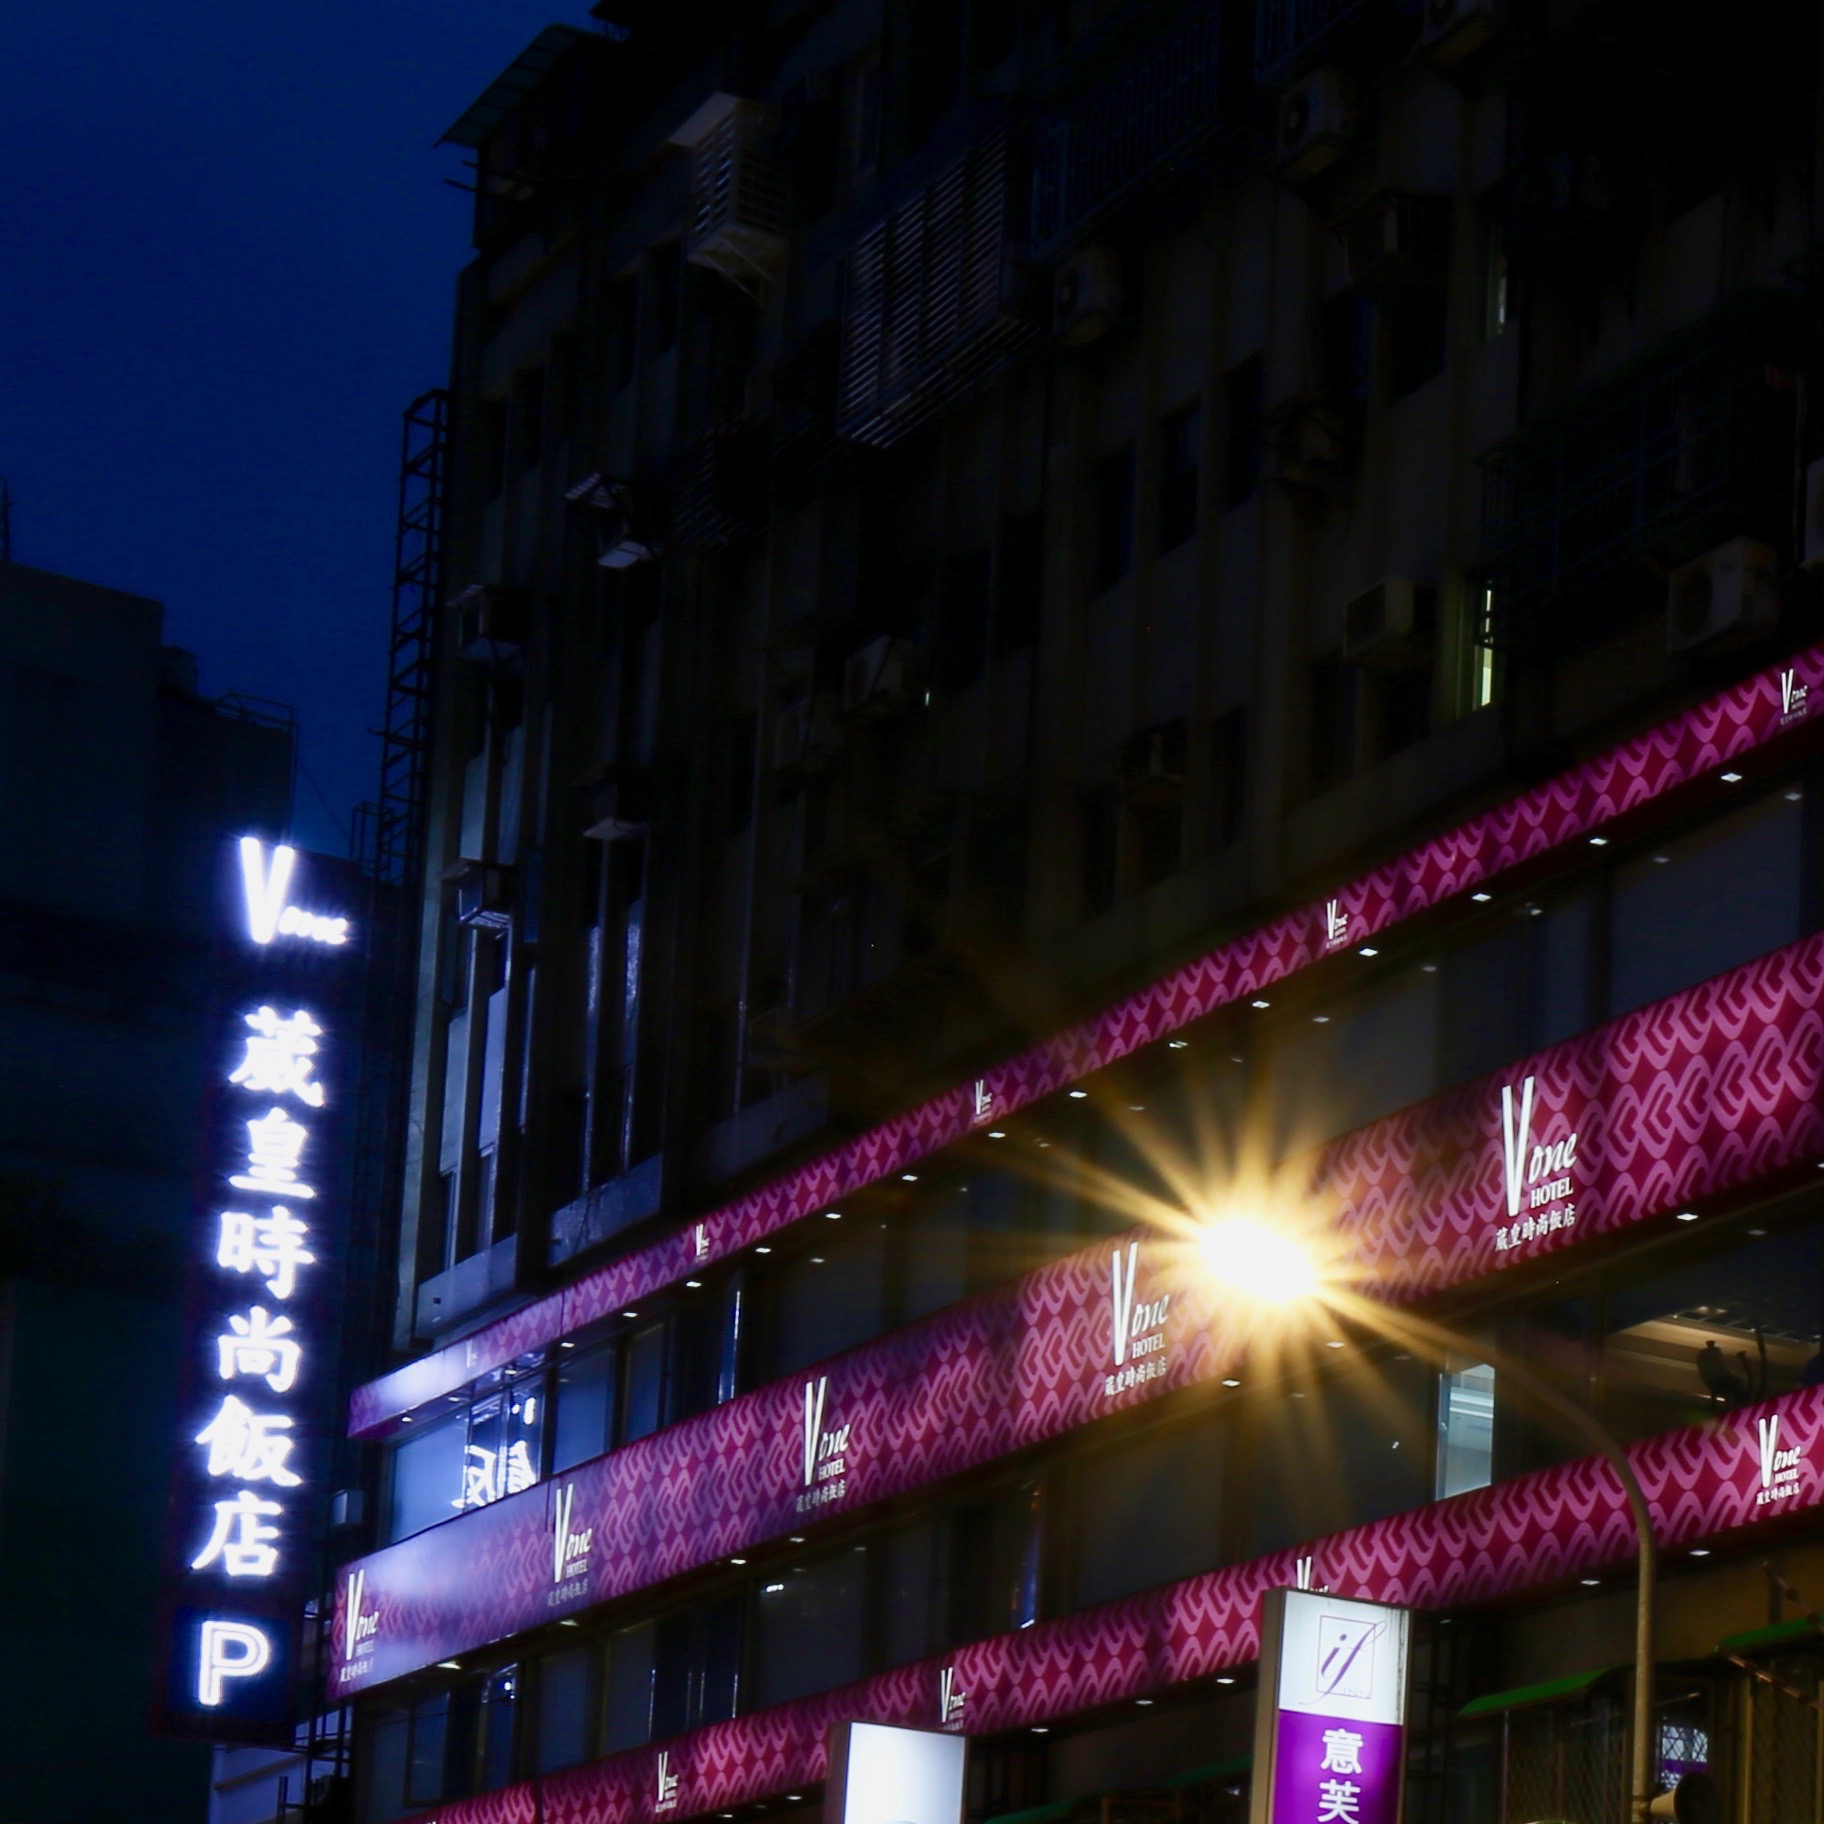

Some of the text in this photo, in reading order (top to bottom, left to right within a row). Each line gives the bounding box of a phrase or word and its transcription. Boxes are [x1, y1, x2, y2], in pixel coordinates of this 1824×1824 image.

[1530, 1176, 1574, 1209] HOTEL
[1131, 1333, 1166, 1360] HOTEL
[818, 1458, 847, 1482] HOTEL
[198, 1619, 272, 1708] P
